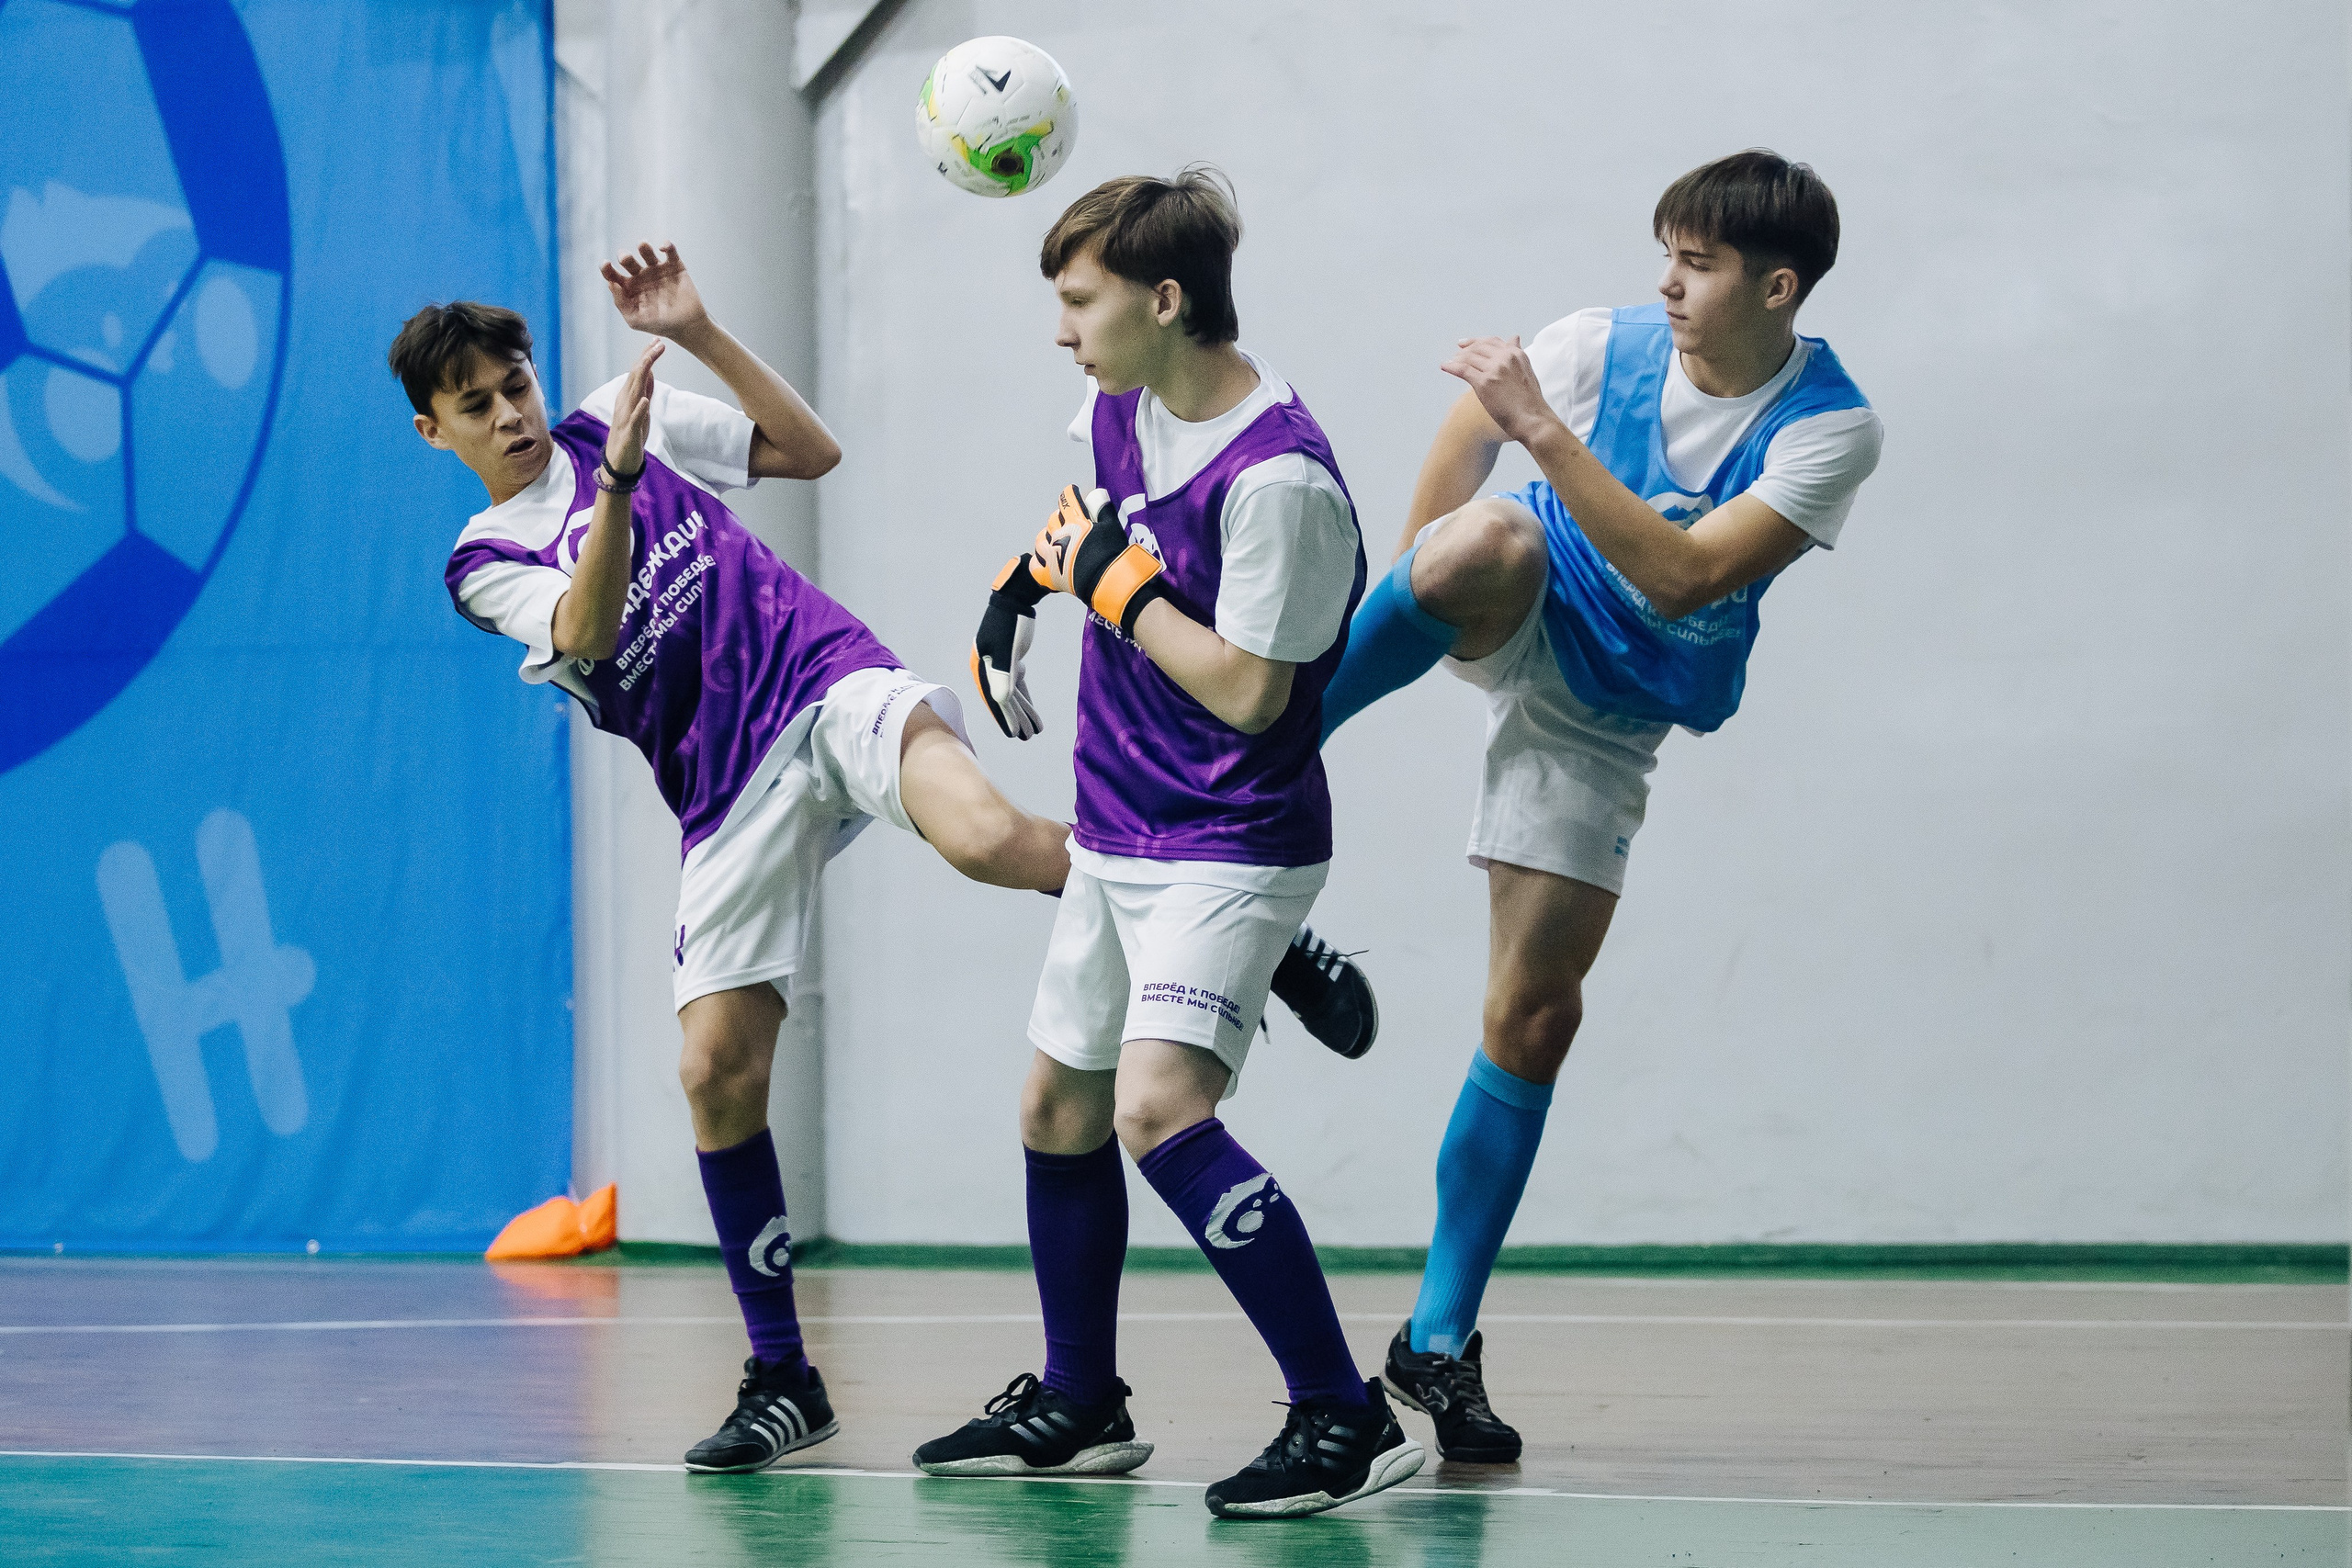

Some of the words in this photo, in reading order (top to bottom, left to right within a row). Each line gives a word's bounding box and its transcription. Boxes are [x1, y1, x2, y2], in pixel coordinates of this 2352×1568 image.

[1143, 982, 1186, 995] ВПЕРЁД
[1189, 987, 1198, 997] К
[1141, 994, 1184, 1004] ВМЕСТЕ
[1187, 998, 1208, 1010] МЫ
